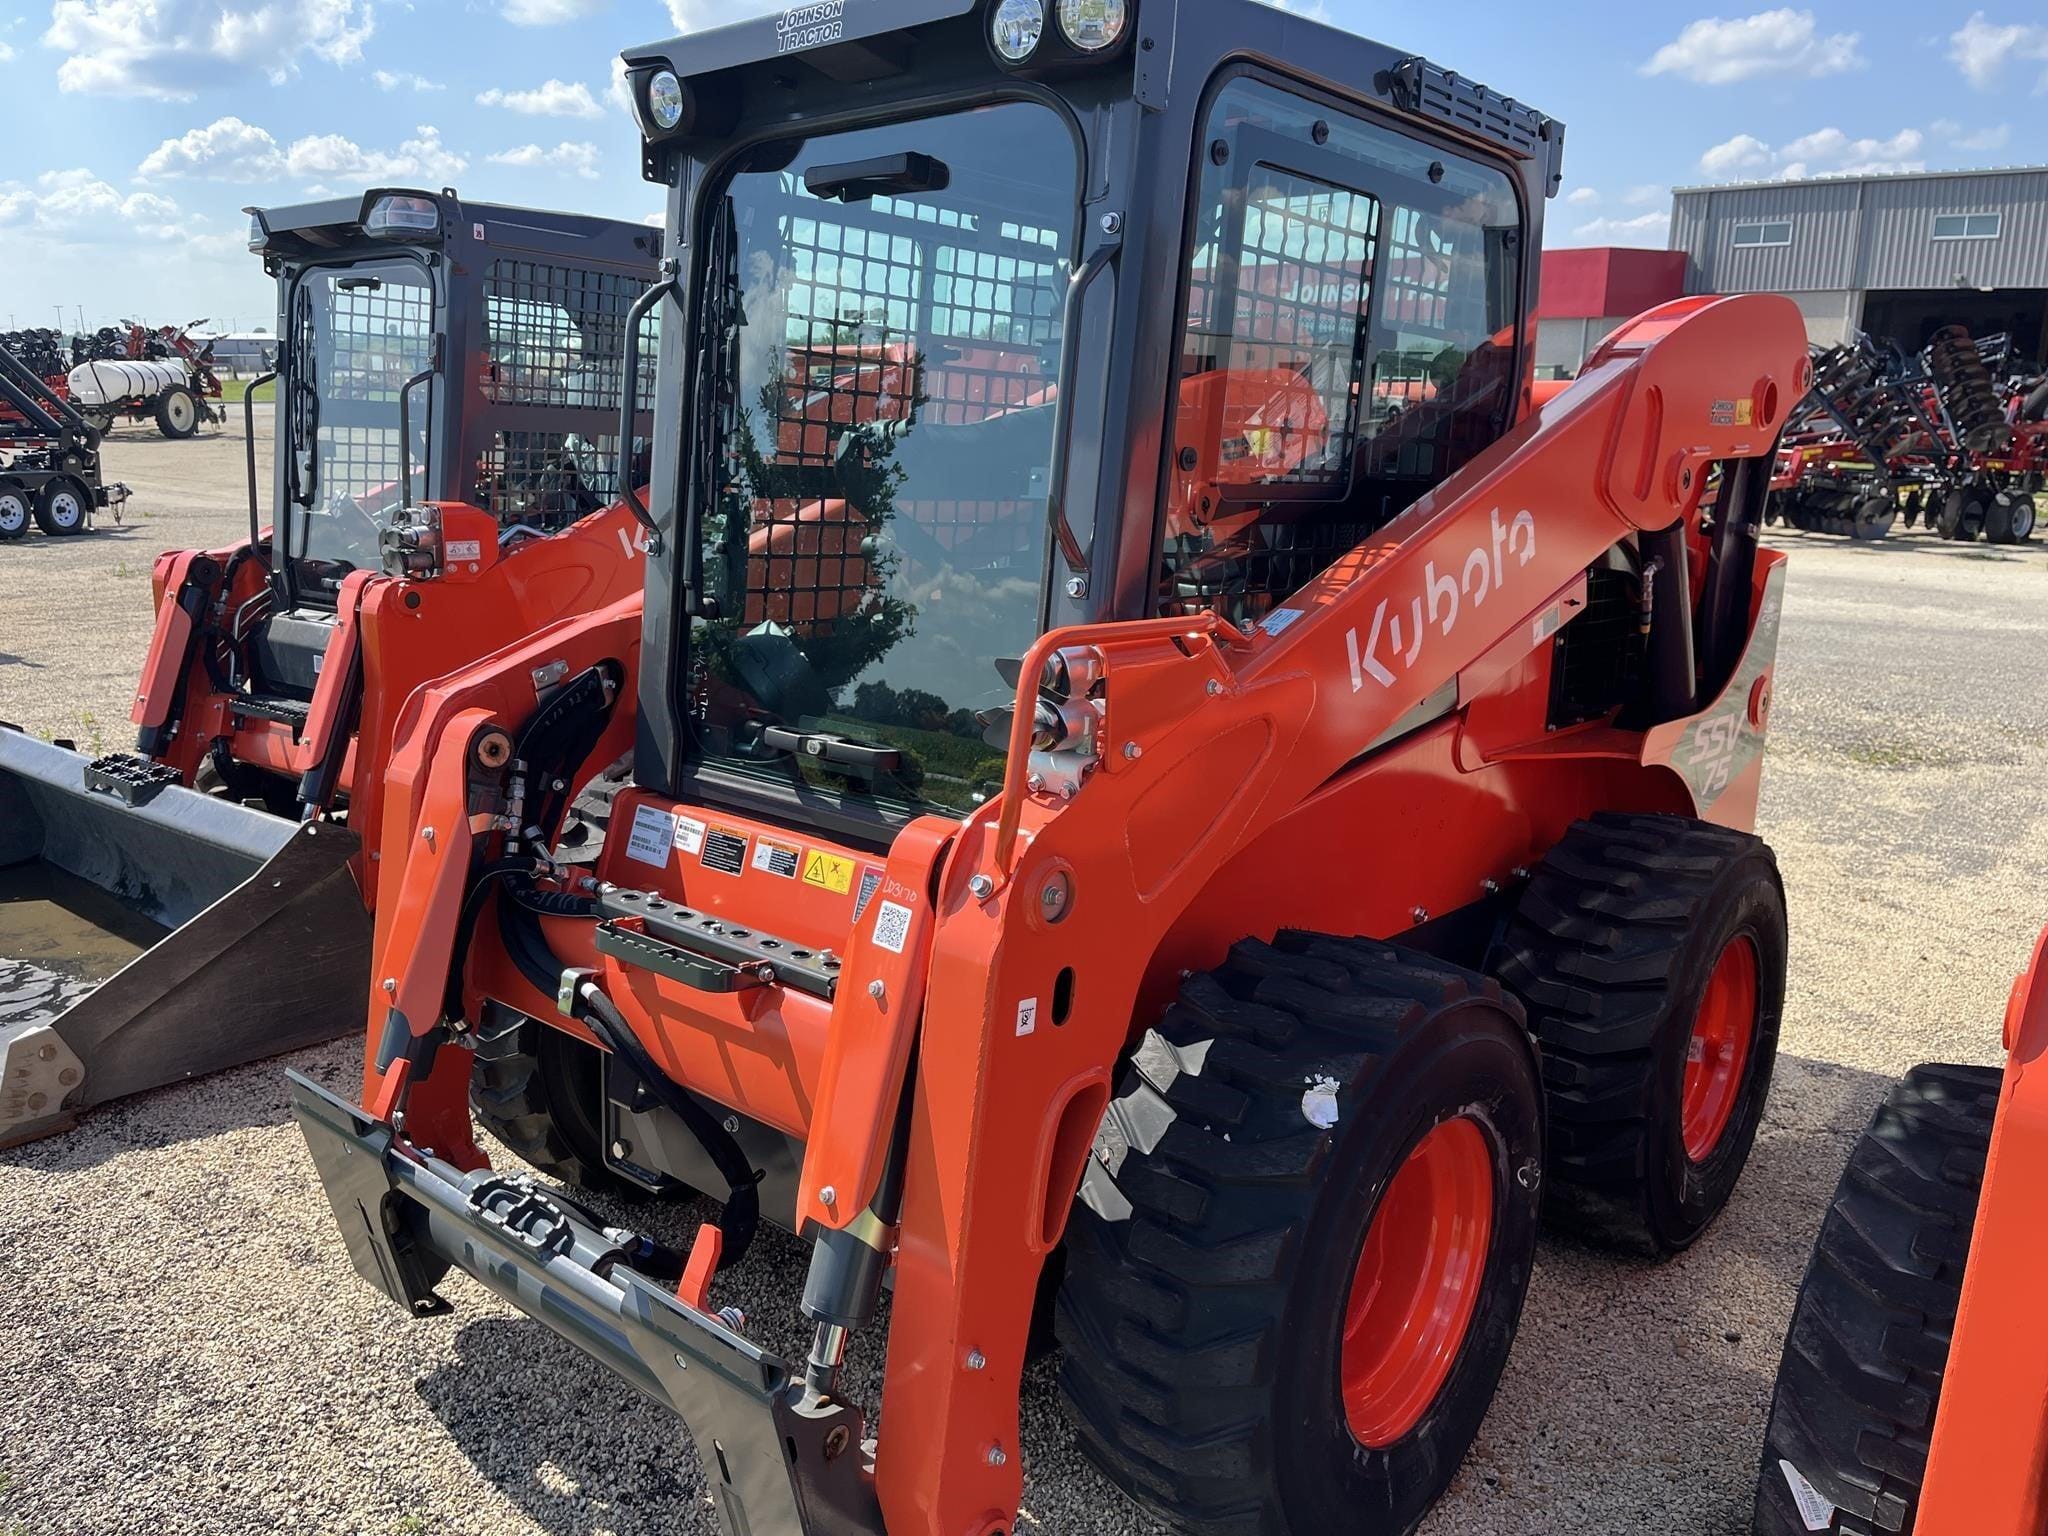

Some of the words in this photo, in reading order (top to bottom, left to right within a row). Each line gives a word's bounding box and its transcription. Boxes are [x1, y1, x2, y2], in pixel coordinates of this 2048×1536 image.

[776, 0, 844, 32] JOHNSON
[777, 21, 842, 52] TRACTOR
[1346, 507, 1536, 694] Kubota
[1688, 708, 1747, 765] SSV
[1701, 754, 1732, 796] 75
